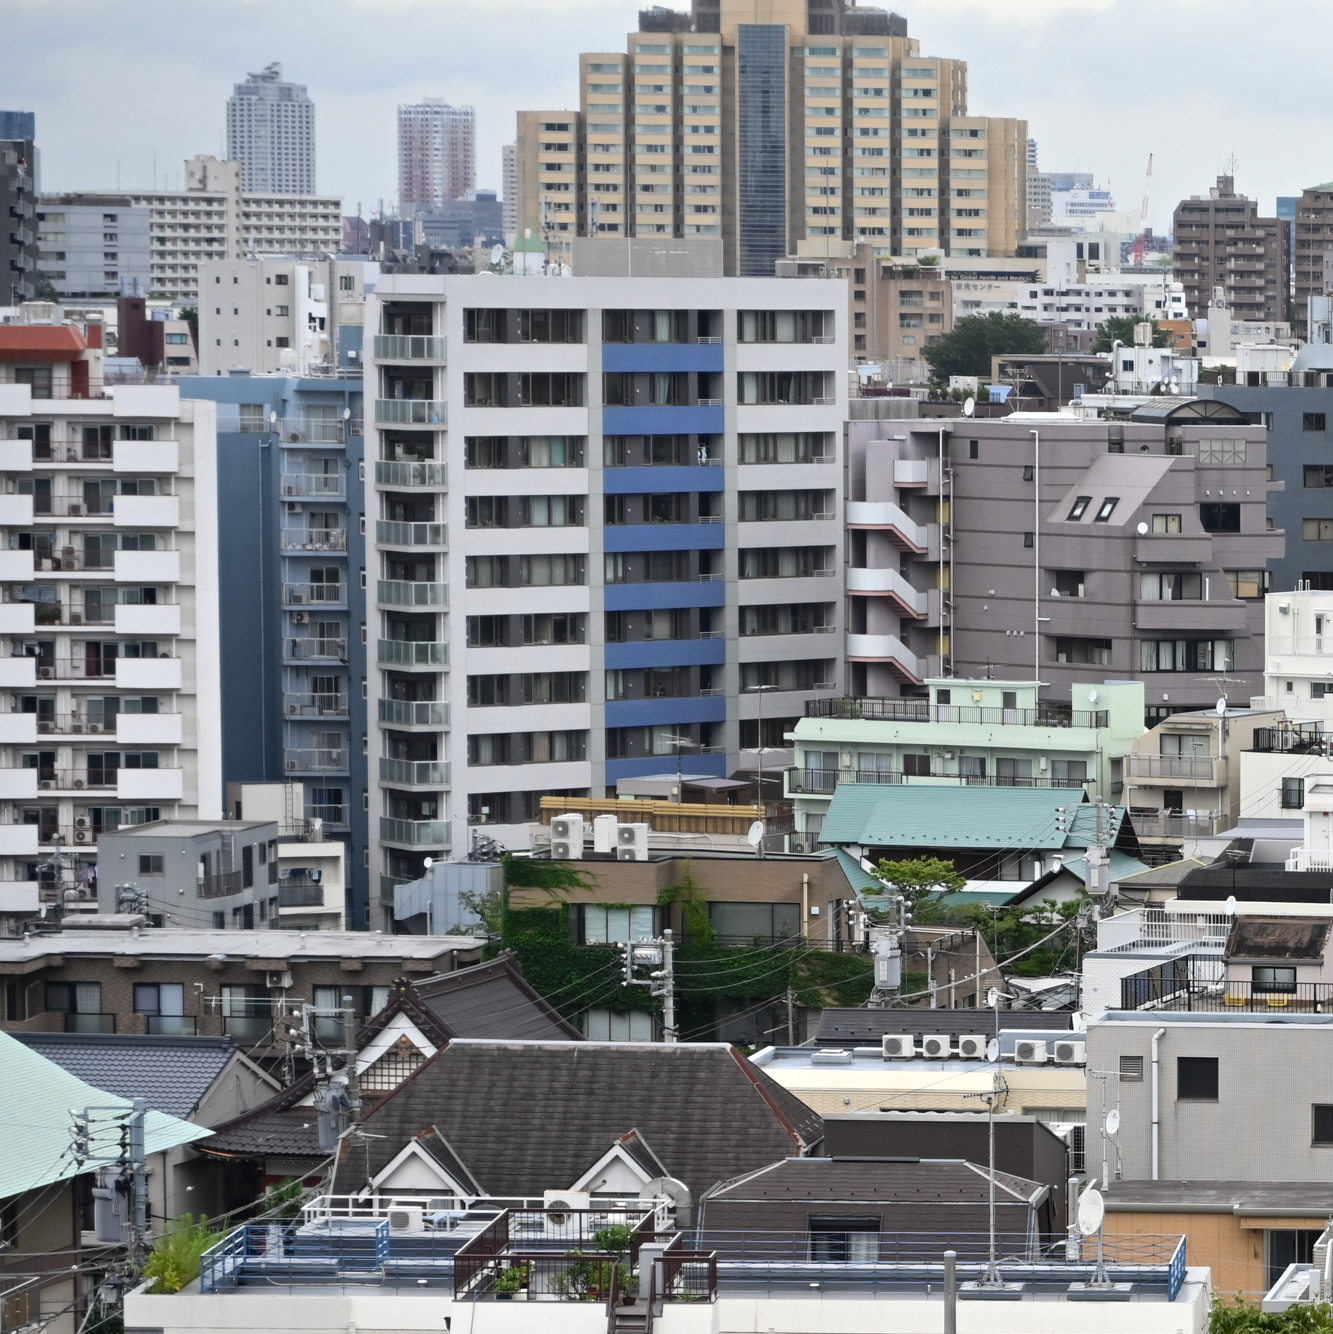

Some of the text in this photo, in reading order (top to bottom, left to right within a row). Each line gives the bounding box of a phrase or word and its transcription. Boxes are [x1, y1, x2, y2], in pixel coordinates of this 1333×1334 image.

[955, 282, 1001, 291] 研究センター
